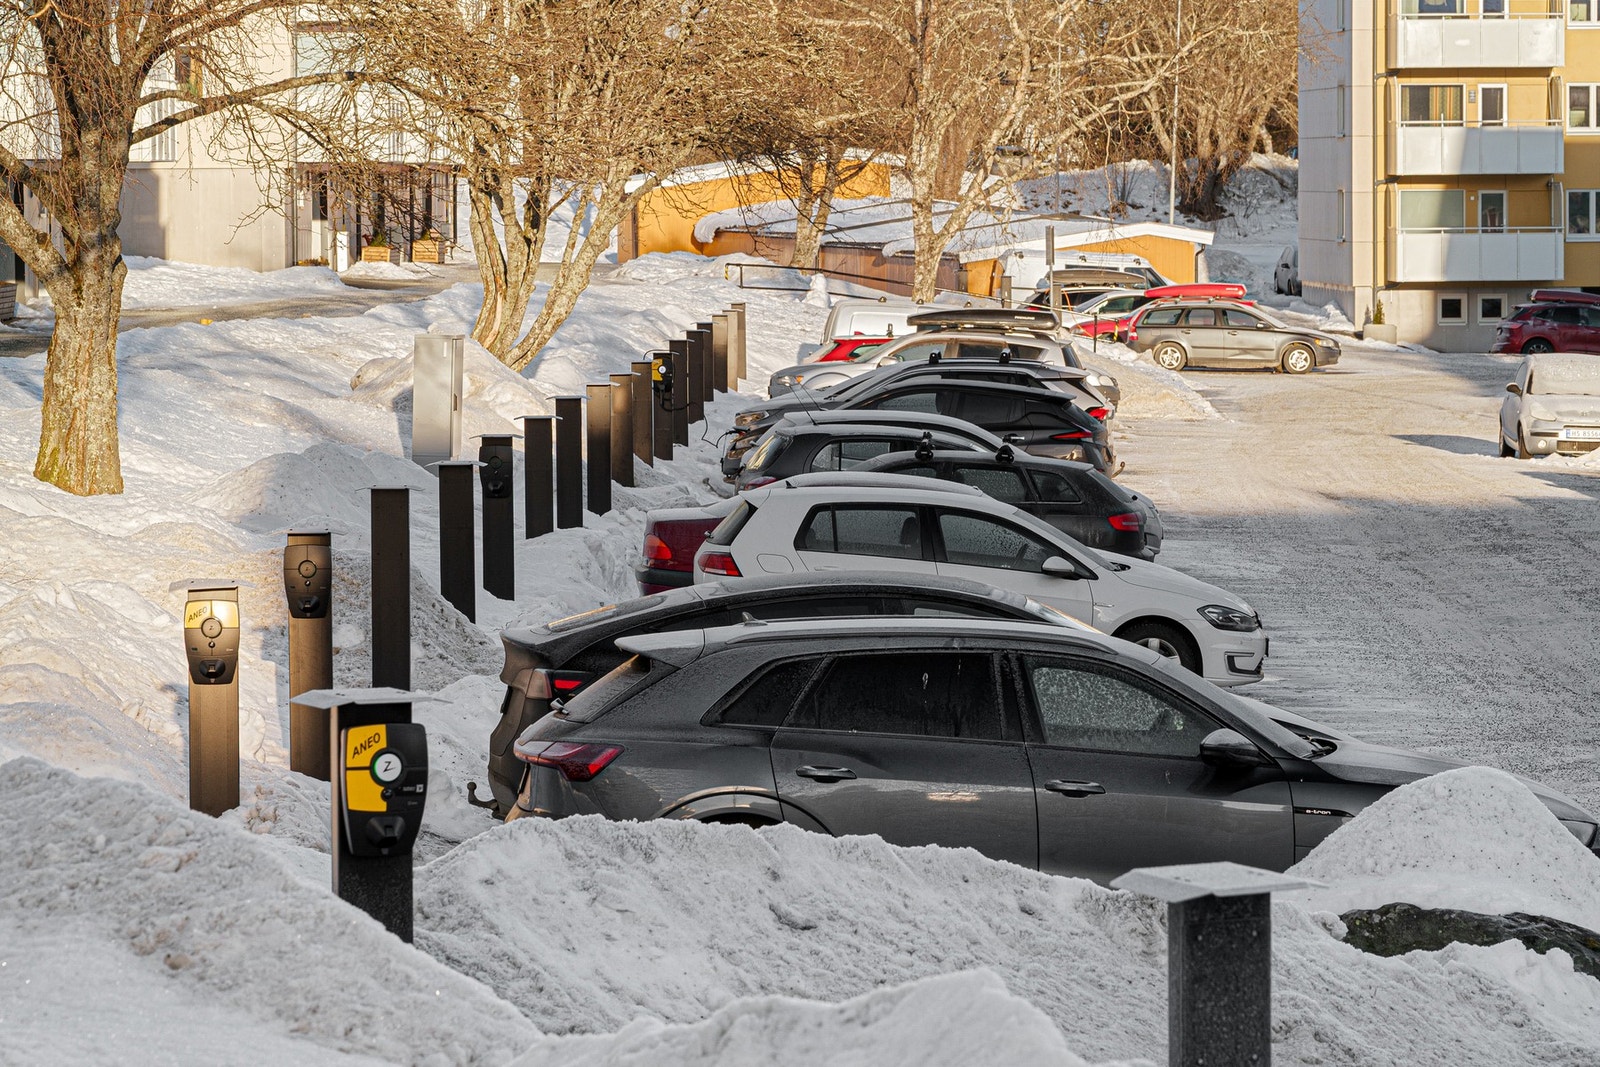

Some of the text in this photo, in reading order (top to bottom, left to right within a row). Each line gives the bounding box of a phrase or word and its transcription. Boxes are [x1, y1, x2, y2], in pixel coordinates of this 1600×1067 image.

[1582, 430, 1600, 438] 8556
[188, 606, 207, 622] ANEO
[352, 732, 381, 759] ANEO
